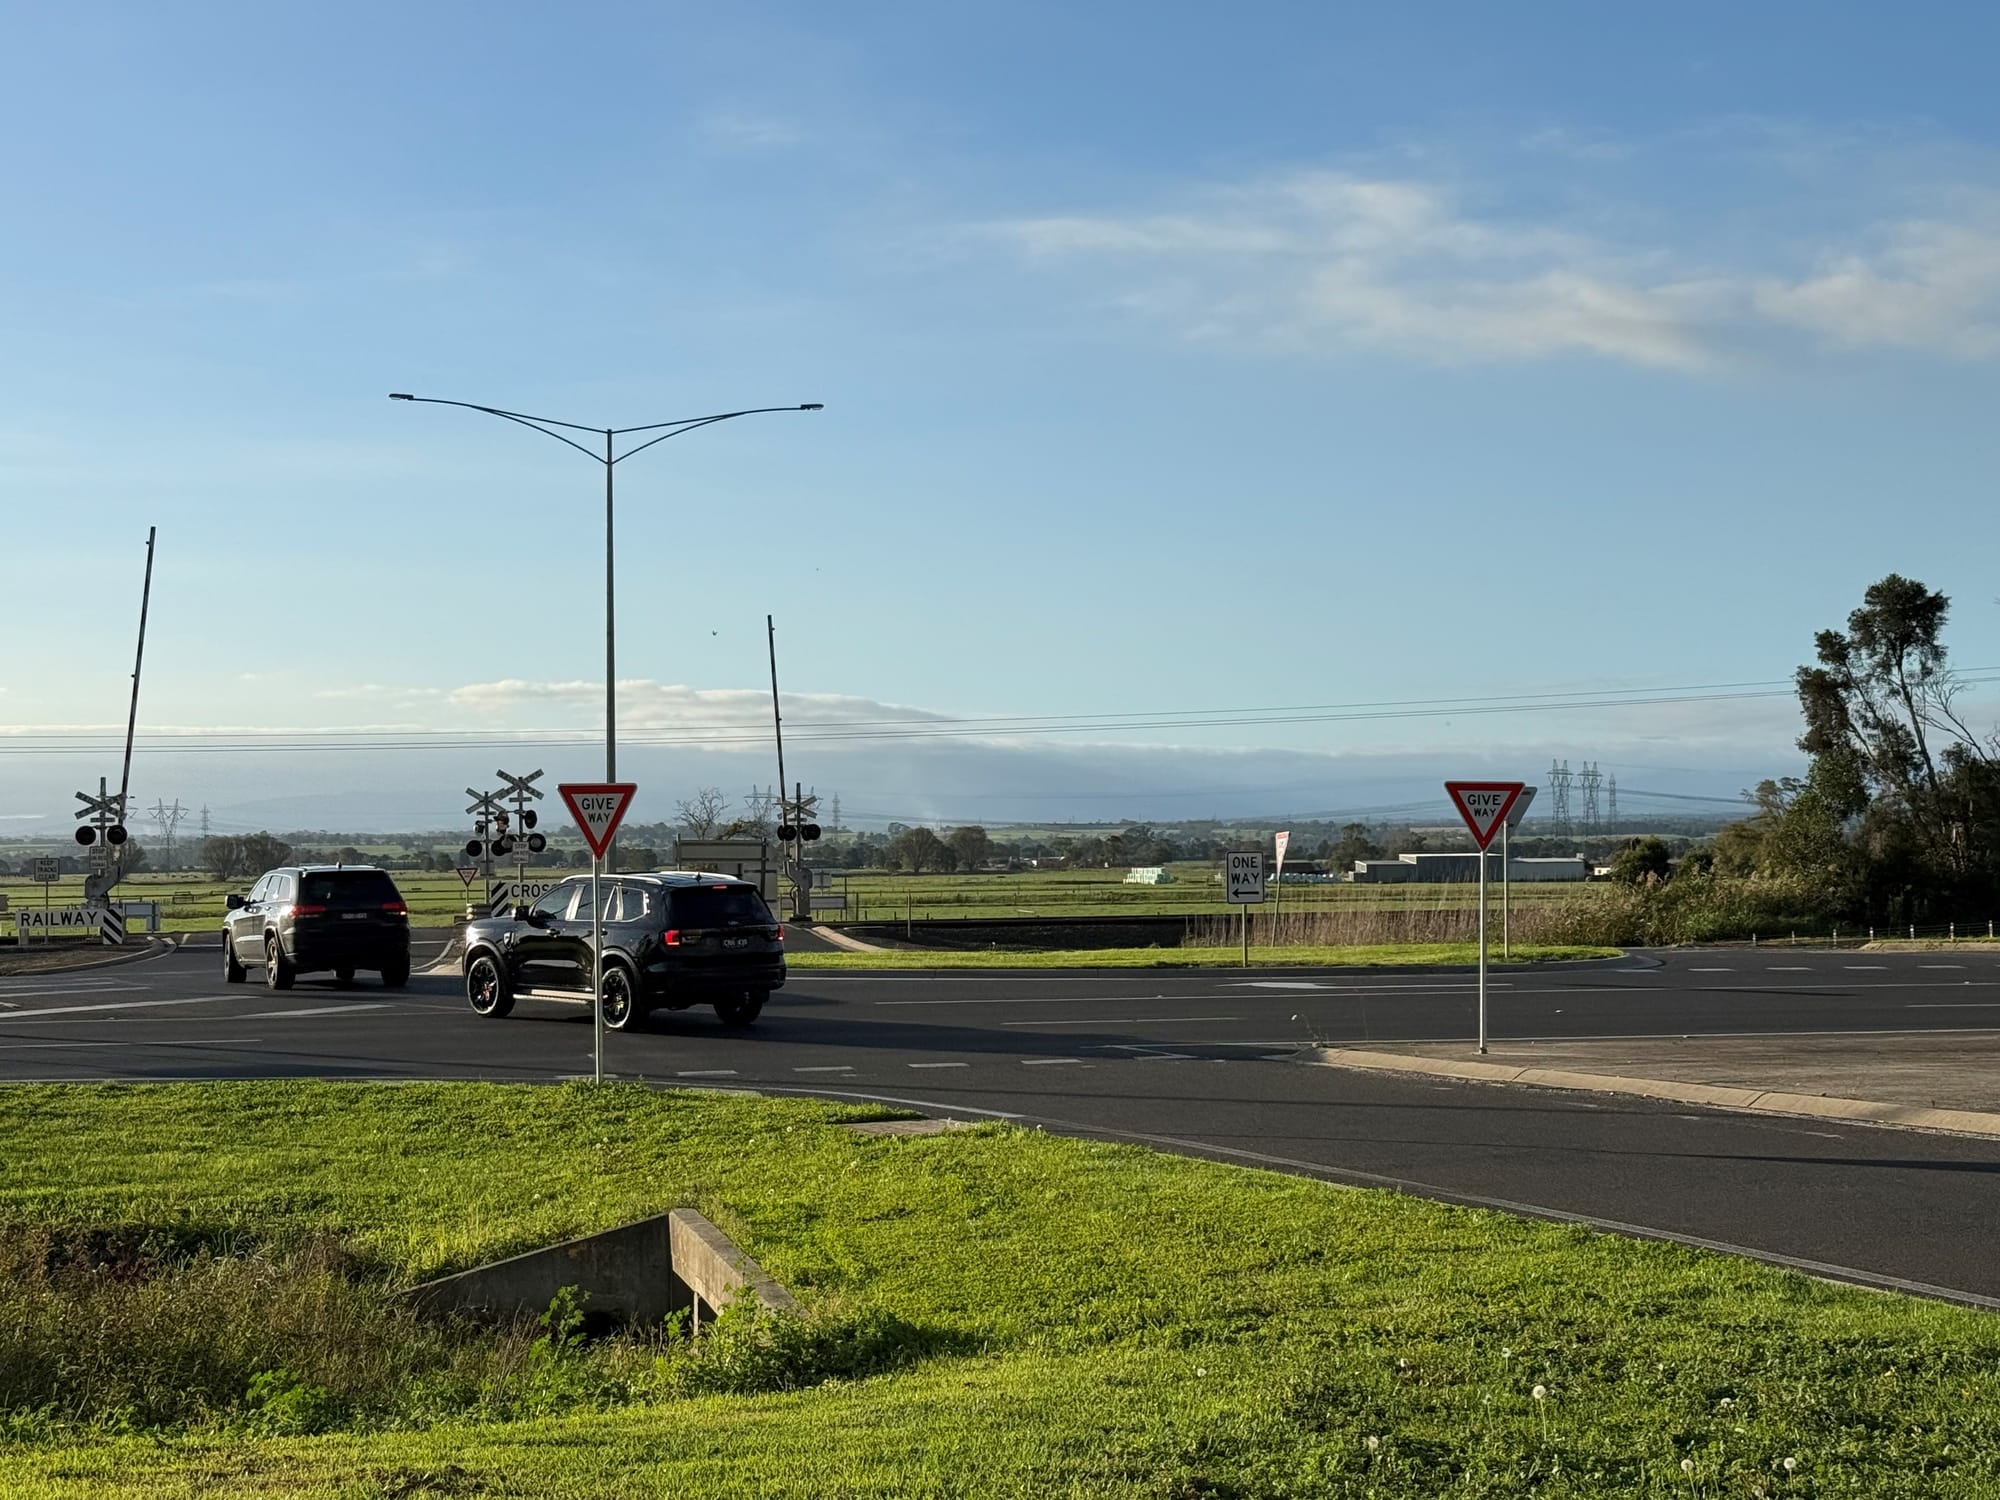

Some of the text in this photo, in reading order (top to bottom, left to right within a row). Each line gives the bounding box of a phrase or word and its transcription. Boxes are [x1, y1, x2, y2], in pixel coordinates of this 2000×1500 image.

[582, 798, 614, 810] GIVE
[1467, 794, 1501, 806] GIVE
[588, 813, 610, 823] WAY
[1474, 808, 1497, 817] WAY
[1232, 856, 1259, 869] ONE
[1231, 873, 1260, 884] WAY
[21, 911, 98, 926] RAILWAY
